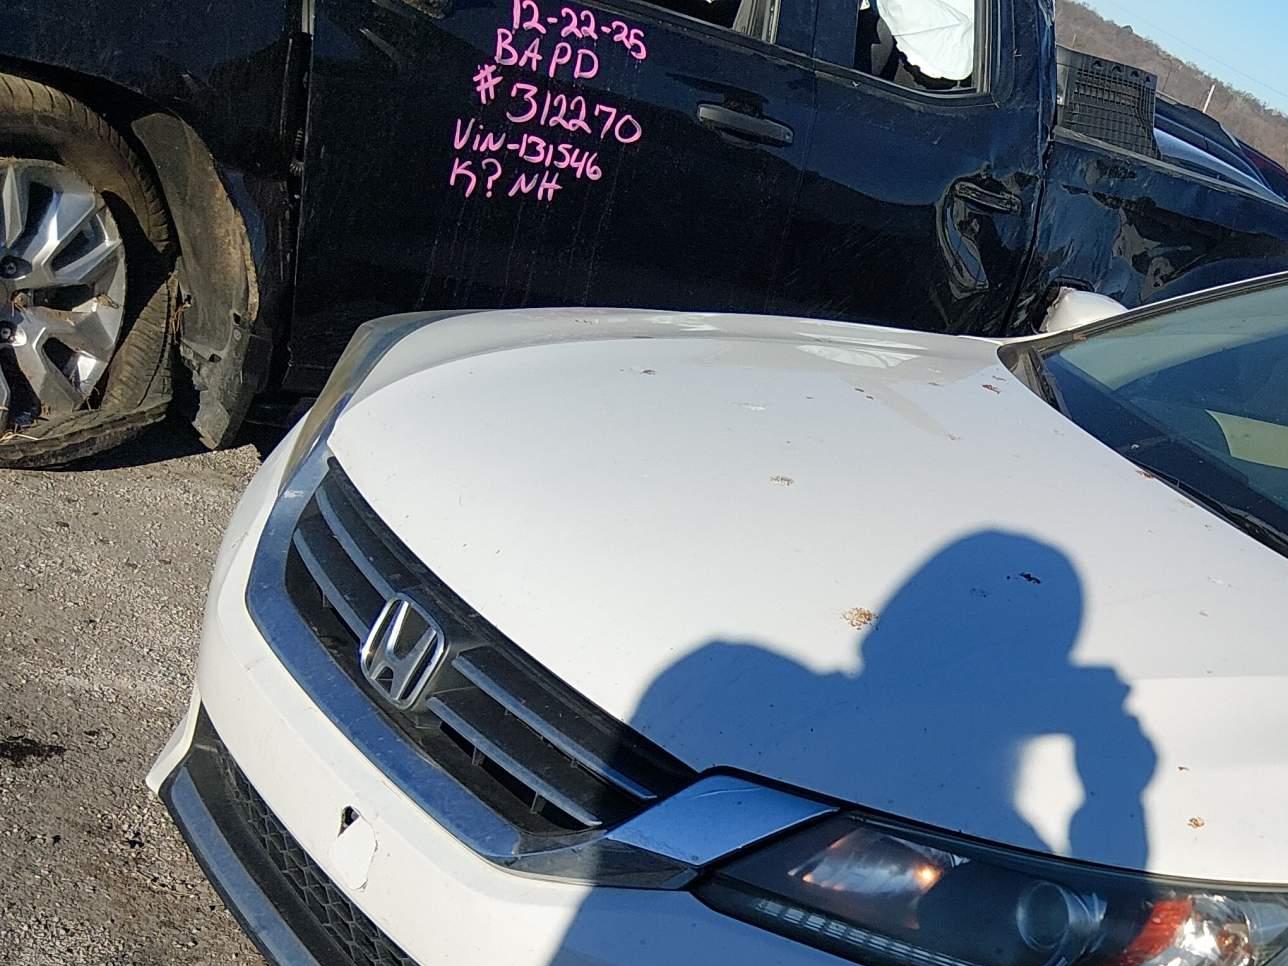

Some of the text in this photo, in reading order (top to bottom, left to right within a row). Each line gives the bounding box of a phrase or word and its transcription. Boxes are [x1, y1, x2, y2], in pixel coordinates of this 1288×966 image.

[511, 0, 647, 60] 12-22-25
[506, 82, 643, 144] 312270
[508, 170, 563, 201] NH
